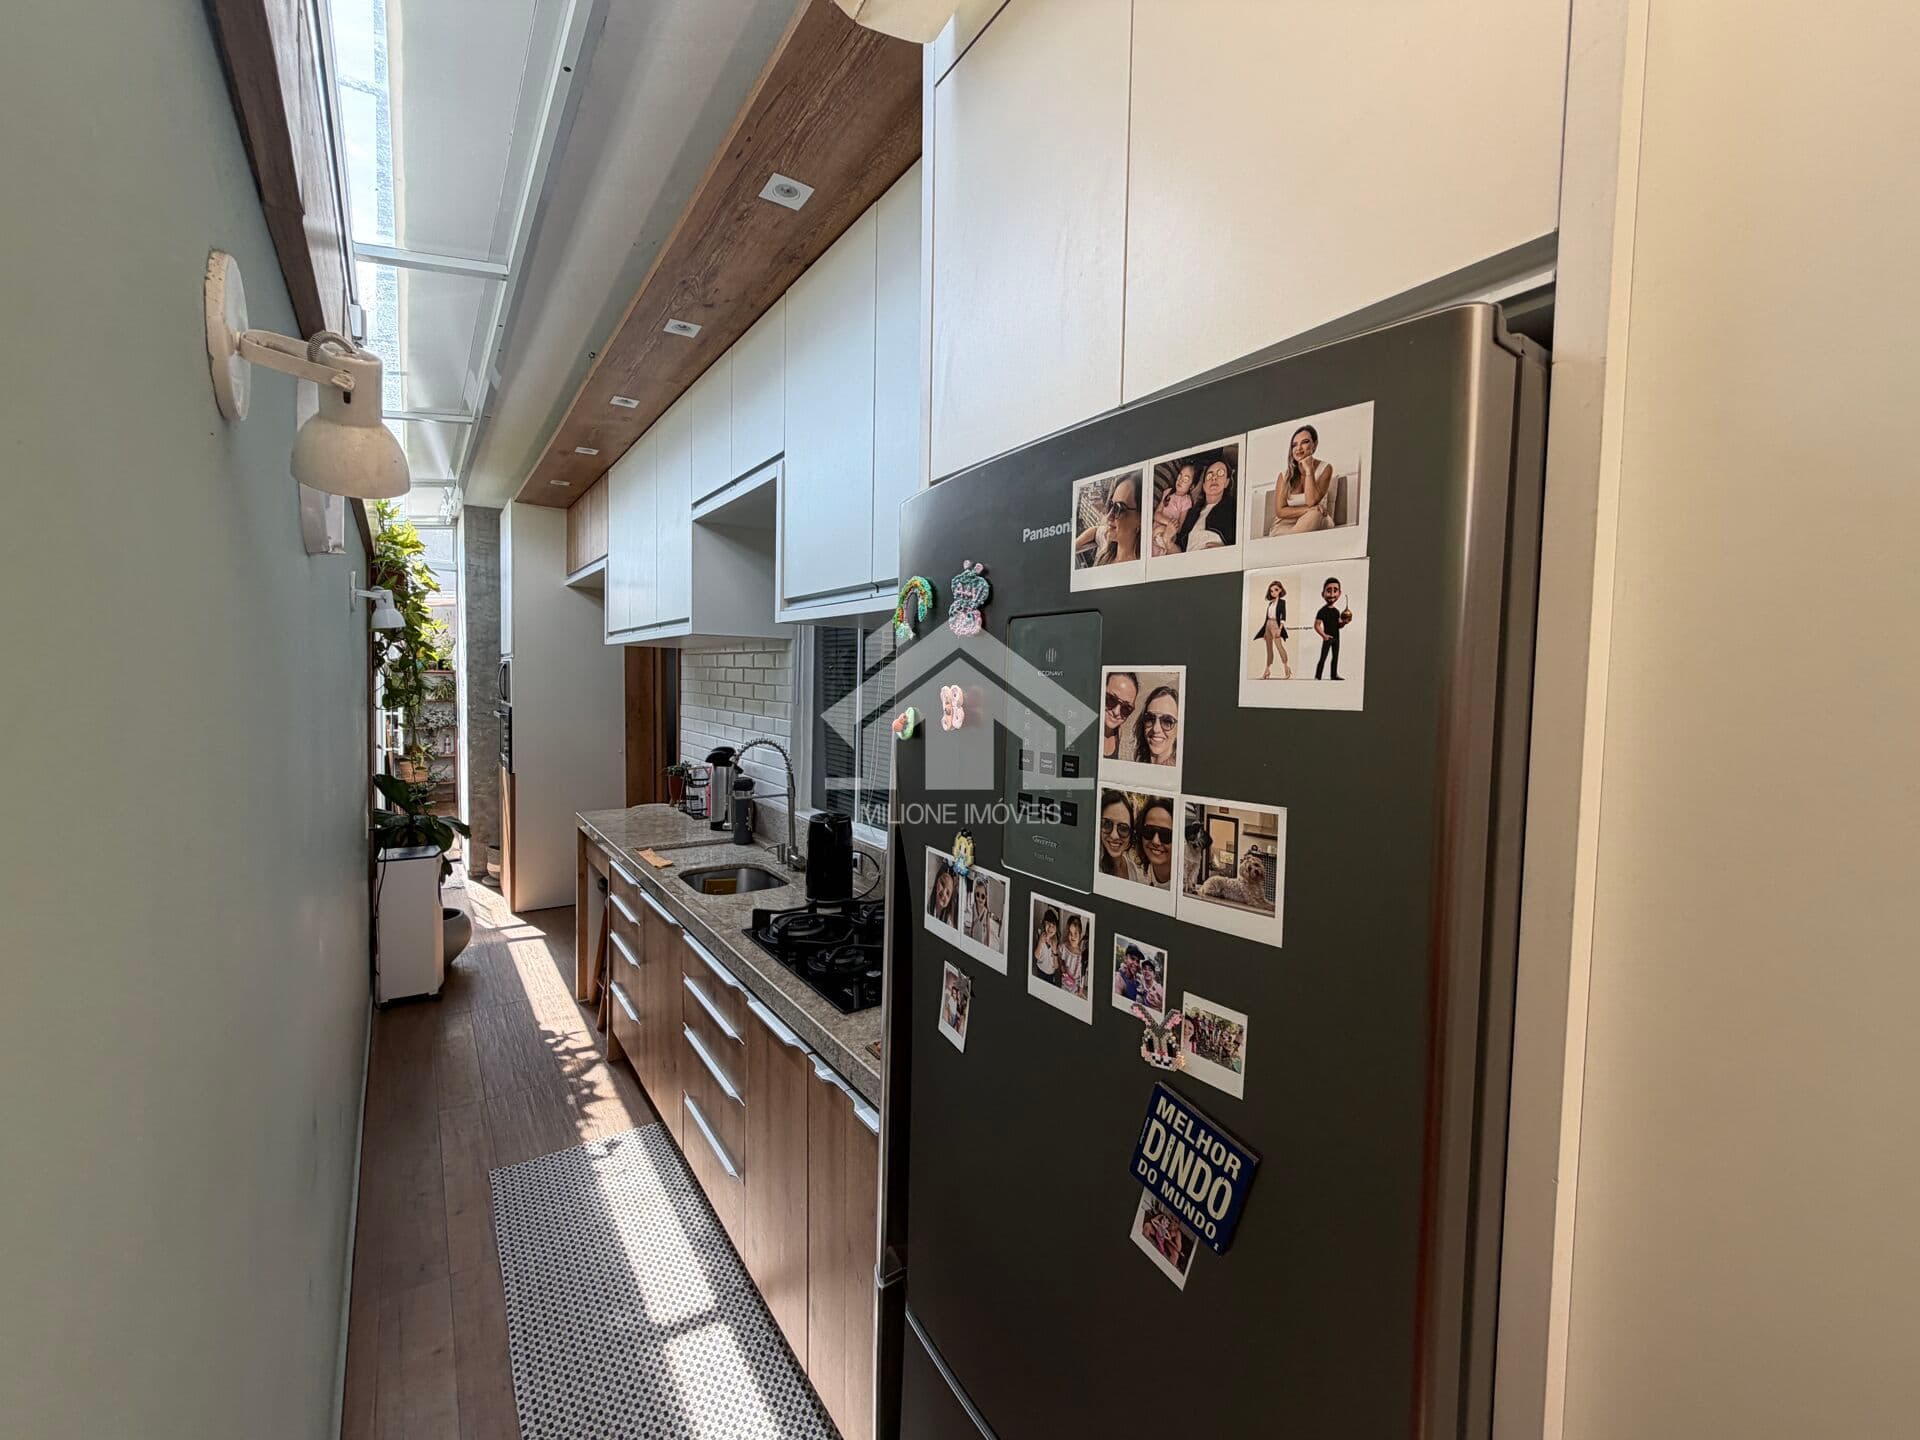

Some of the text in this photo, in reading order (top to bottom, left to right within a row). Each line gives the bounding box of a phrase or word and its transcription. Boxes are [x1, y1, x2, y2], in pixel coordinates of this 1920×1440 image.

[1142, 1118, 1233, 1221] DINDO
[1156, 1095, 1242, 1181] MELHOR
[1137, 1158, 1217, 1240] DO MUNDO
